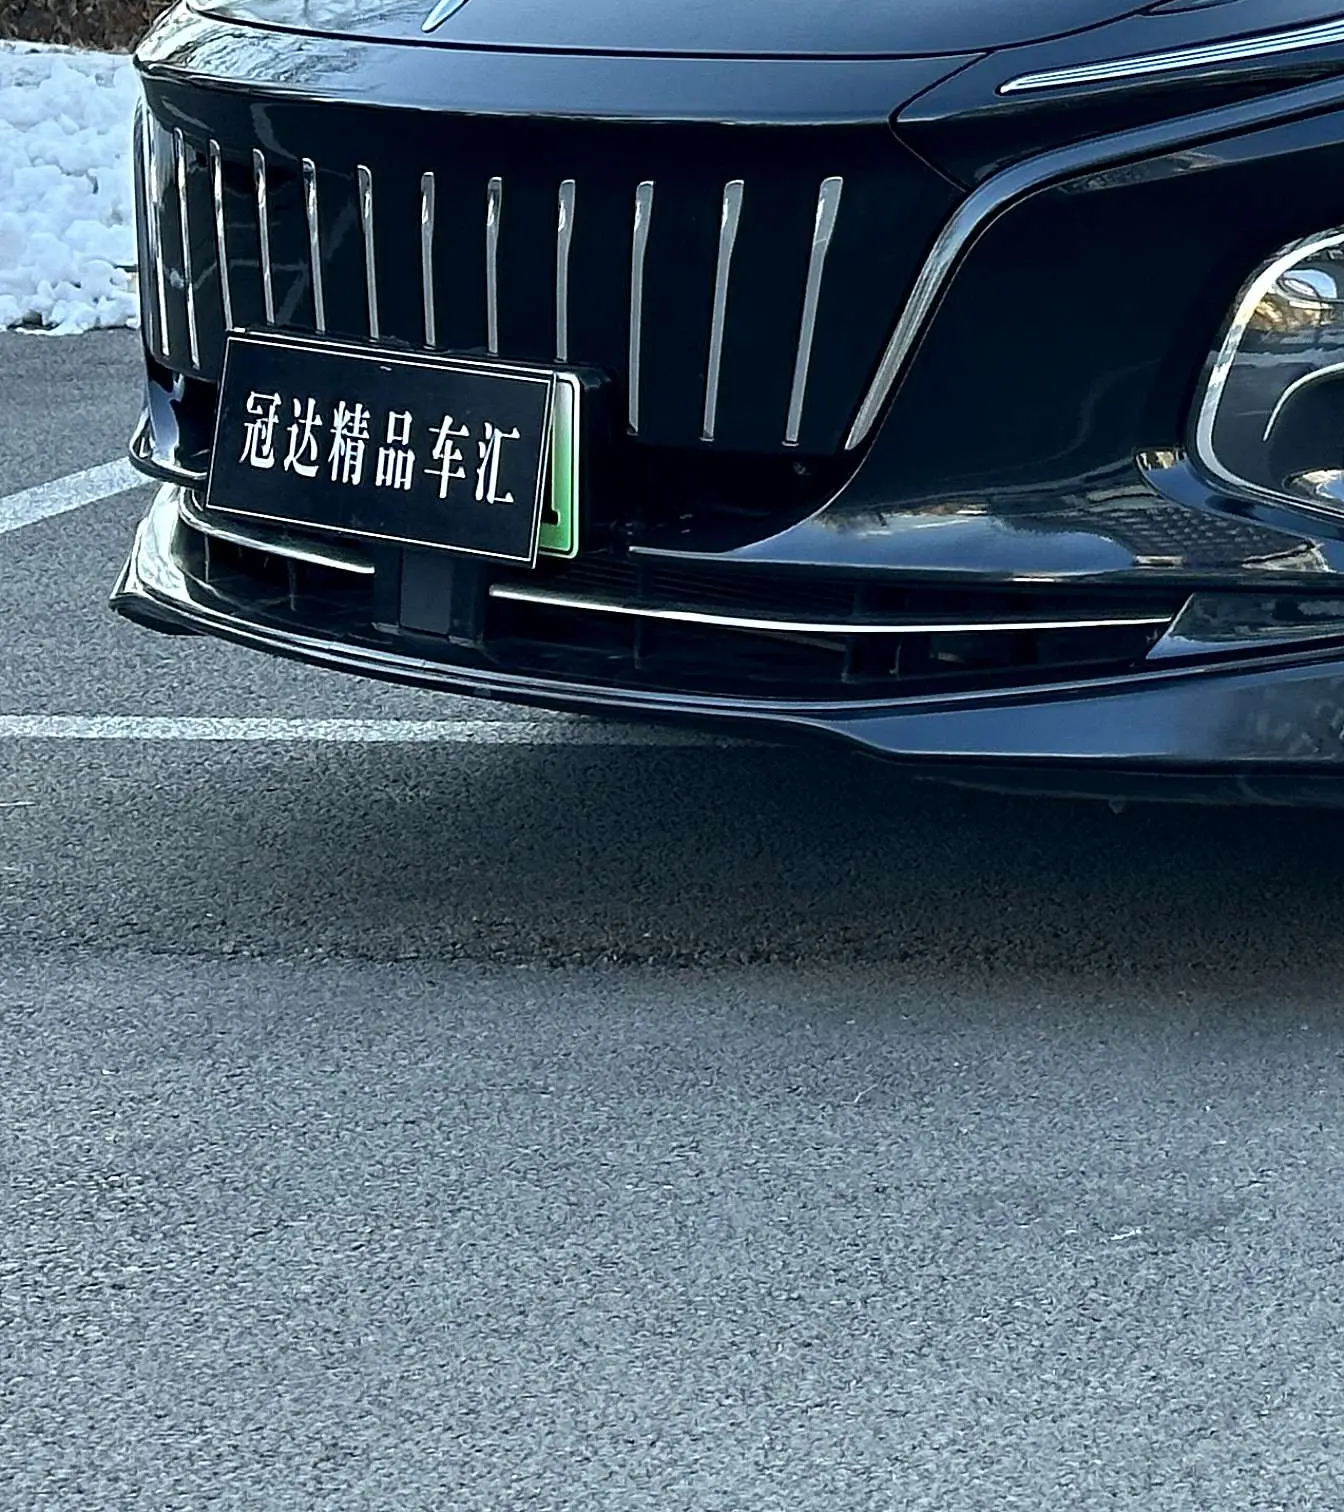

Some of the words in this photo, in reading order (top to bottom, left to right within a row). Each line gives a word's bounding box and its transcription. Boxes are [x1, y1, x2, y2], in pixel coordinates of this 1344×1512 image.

[239, 390, 521, 505] 冠达精品车汇
